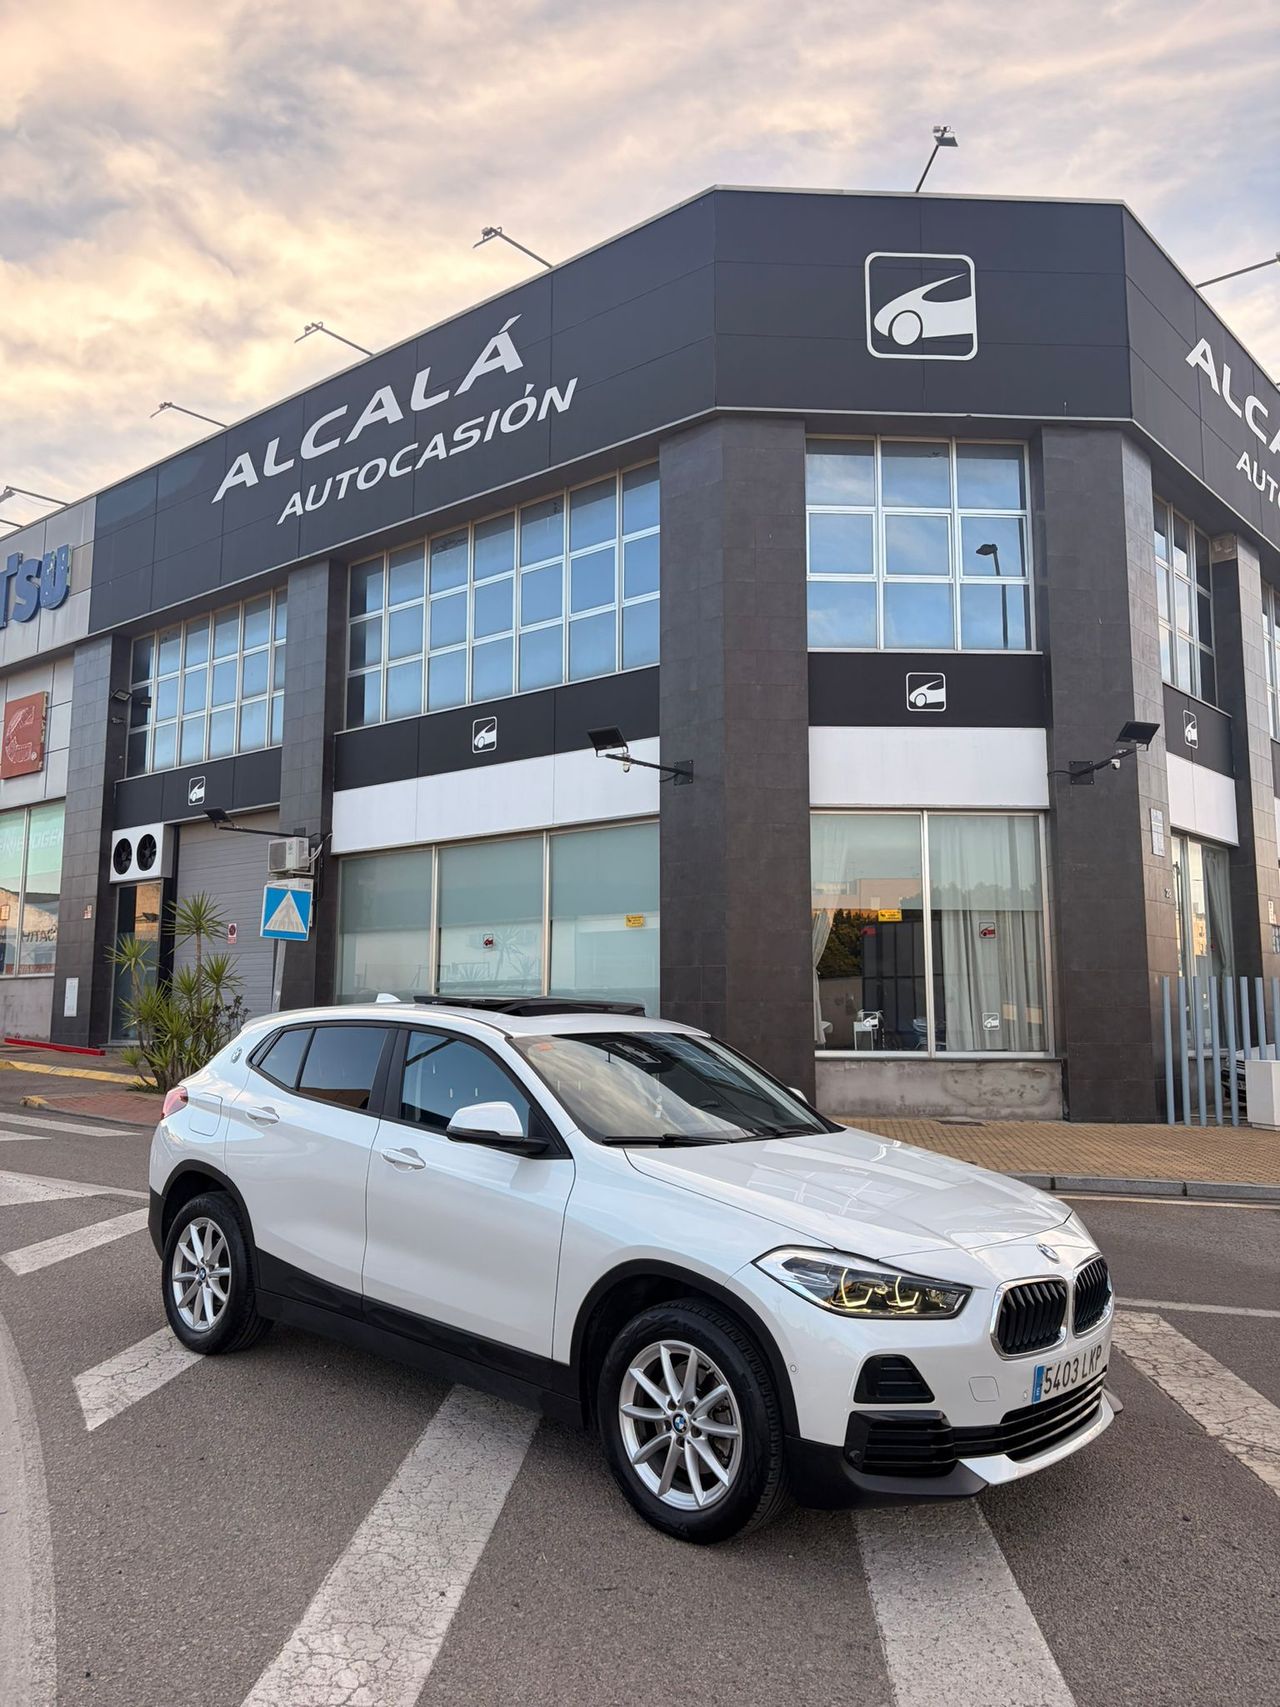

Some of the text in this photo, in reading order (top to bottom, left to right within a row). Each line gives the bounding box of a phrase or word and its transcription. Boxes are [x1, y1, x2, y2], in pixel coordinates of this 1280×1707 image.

[211, 313, 524, 503] ALCALÁ
[276, 377, 578, 525] AUTOCASIÓN
[1236, 451, 1280, 511] AUT
[1043, 1344, 1102, 1394] 5403 LKP
